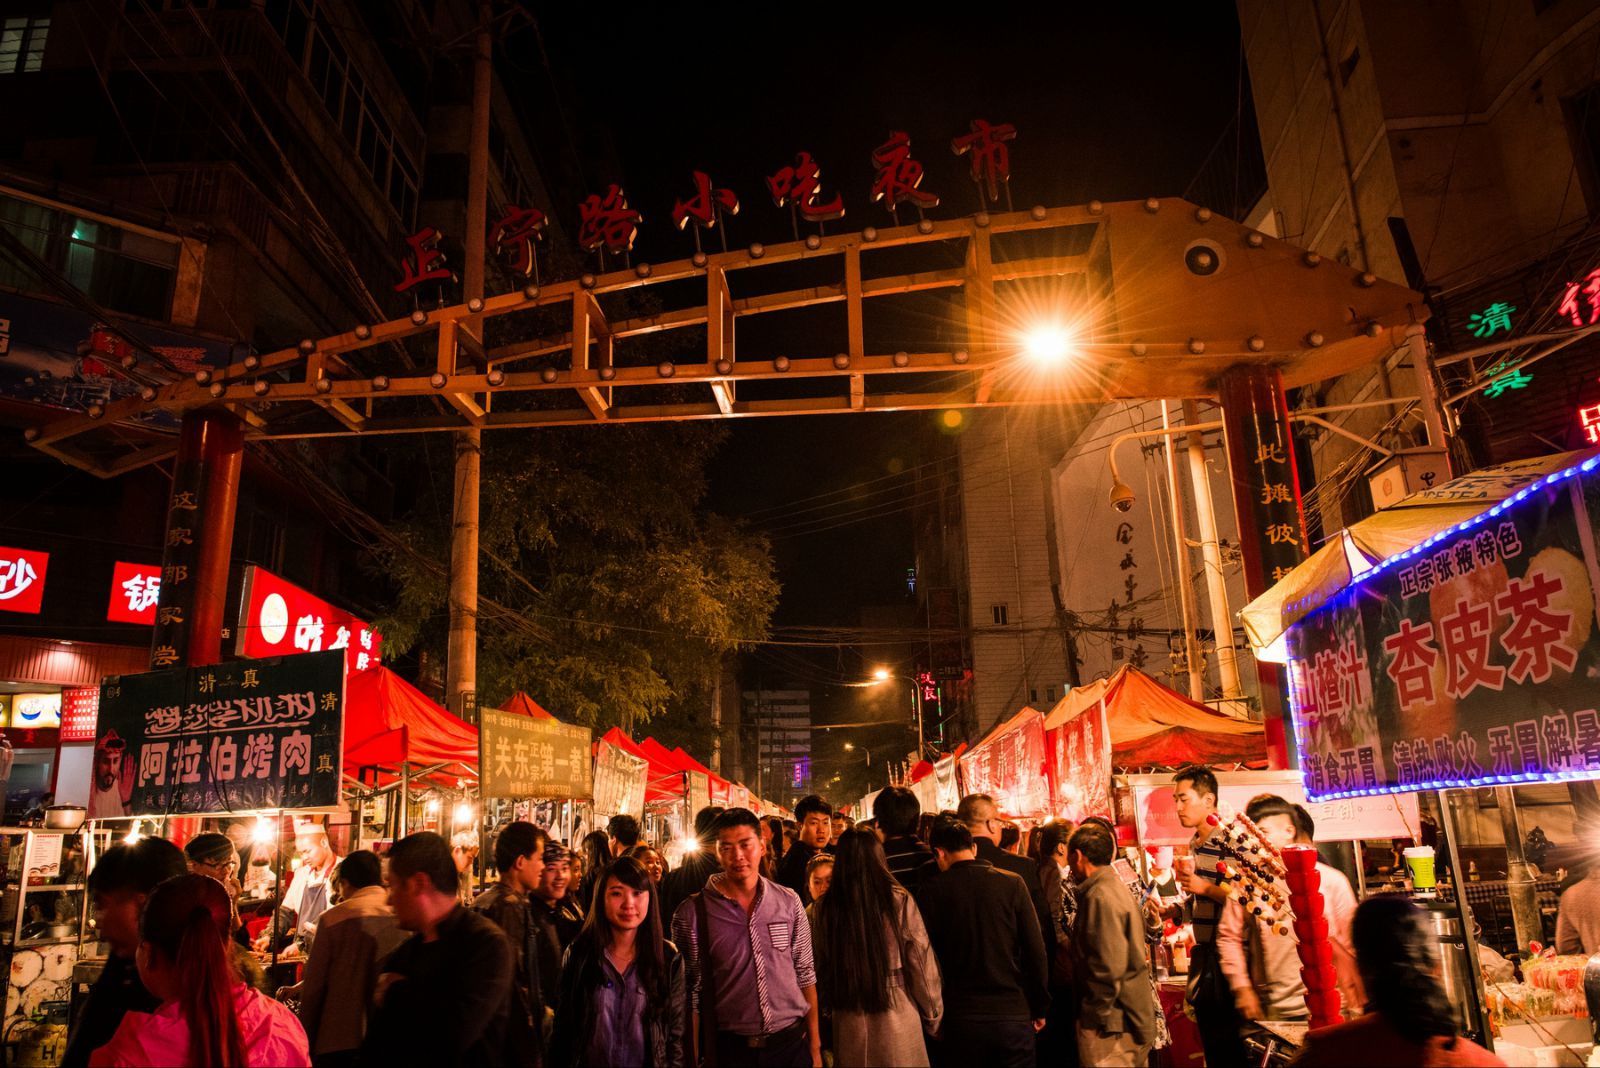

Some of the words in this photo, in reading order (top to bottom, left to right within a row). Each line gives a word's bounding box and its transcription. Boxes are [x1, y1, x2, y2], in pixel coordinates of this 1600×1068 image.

[395, 119, 1018, 293] 正宁路小吃夜市
[152, 490, 198, 666] 这家那家尝
[1399, 522, 1522, 599] 正宗张掖特色
[1300, 642, 1365, 716] 山楂汁
[1384, 573, 1578, 711] 杏皮茶
[138, 729, 313, 788] 阿拉伯烤肉
[1308, 746, 1378, 791] 消食开胃
[1393, 731, 1482, 783] 清热败火
